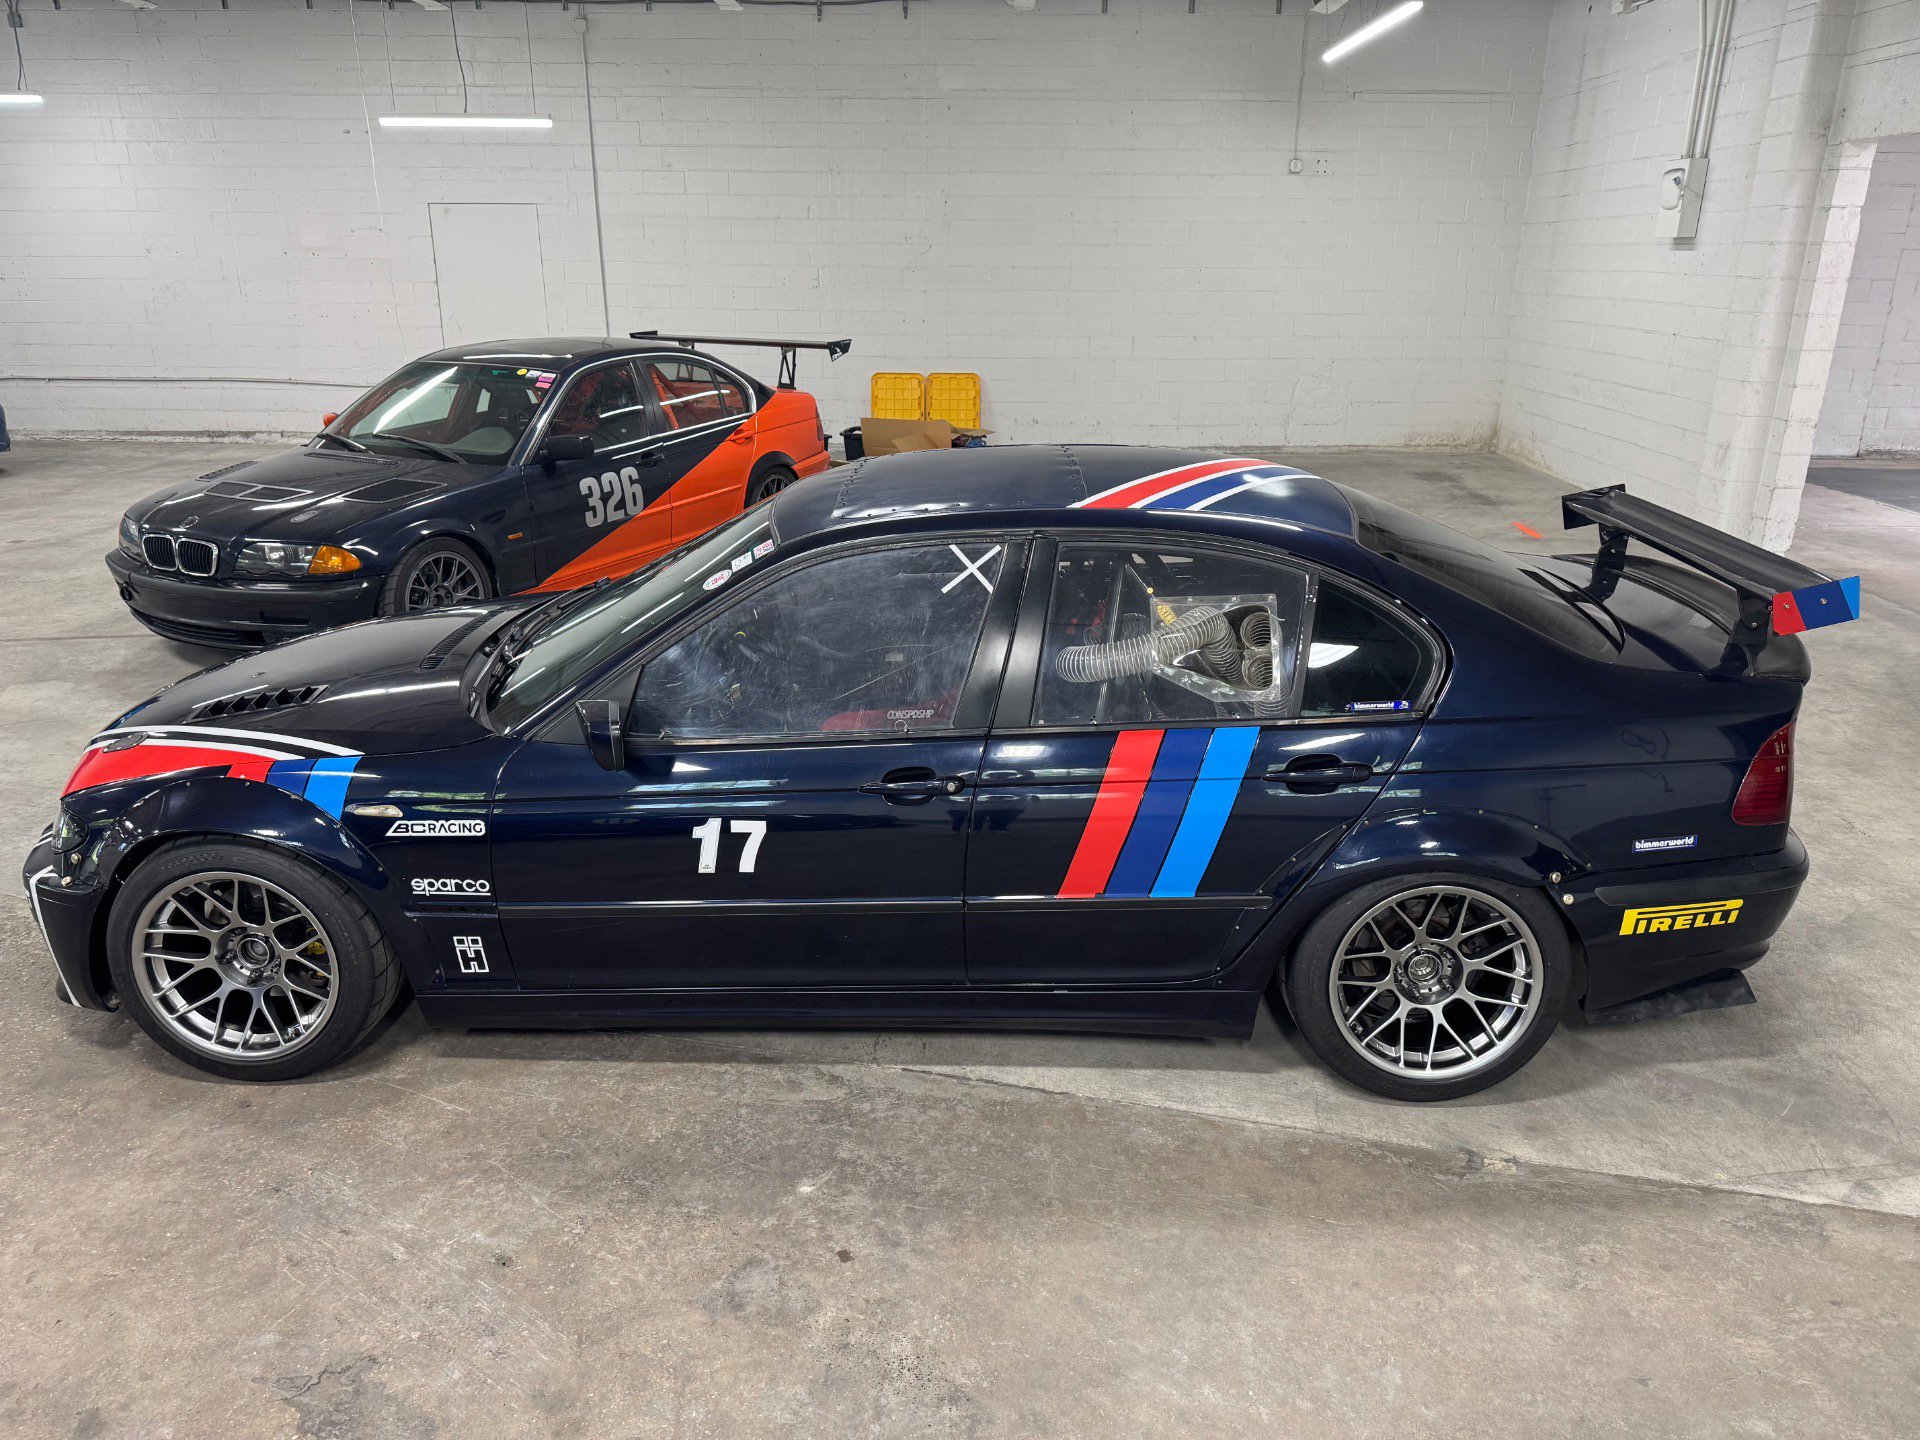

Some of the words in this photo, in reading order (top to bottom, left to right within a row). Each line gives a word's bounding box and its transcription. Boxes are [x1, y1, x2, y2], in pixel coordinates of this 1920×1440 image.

[579, 466, 644, 528] 326
[692, 817, 767, 874] 17
[1635, 836, 1694, 849] bimmerworld
[411, 878, 491, 896] sparco
[1619, 898, 1744, 936] PIRELLI
